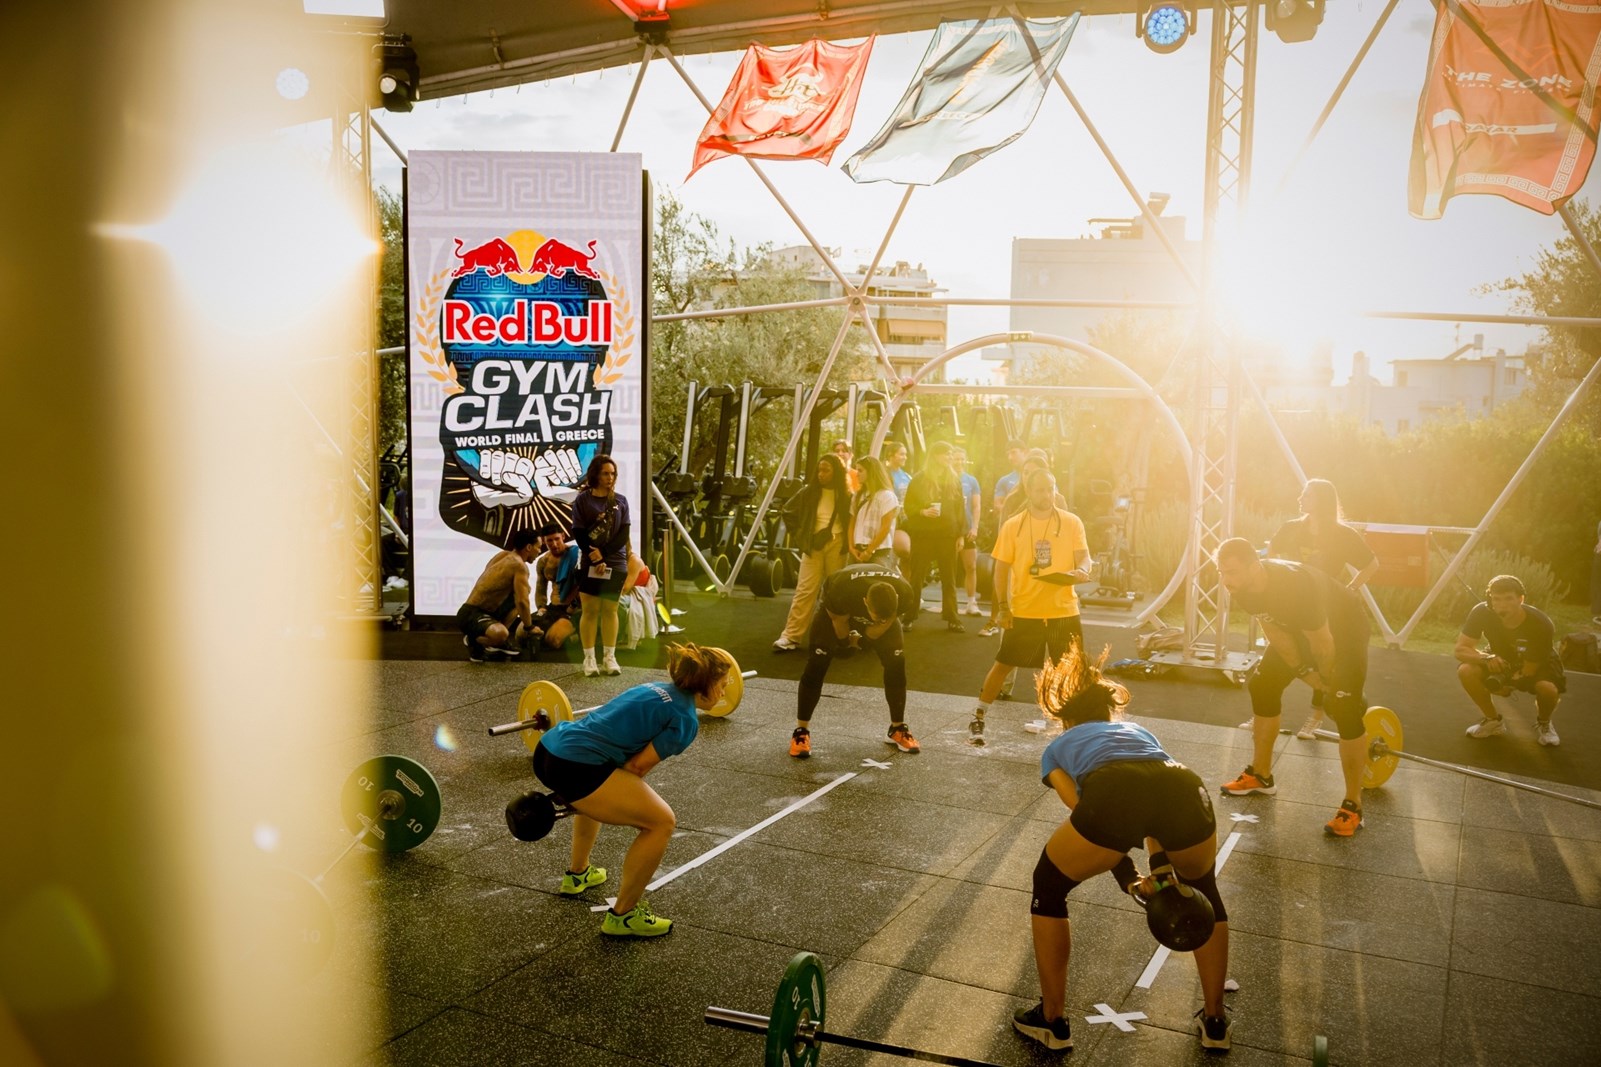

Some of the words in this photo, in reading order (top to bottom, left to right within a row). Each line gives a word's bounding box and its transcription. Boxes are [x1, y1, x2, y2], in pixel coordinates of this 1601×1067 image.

[1445, 64, 1492, 82] THE
[1500, 73, 1573, 90] ZONE
[444, 300, 526, 342] Red
[533, 301, 613, 343] Bull
[471, 359, 589, 395] GYM
[445, 391, 611, 442] CLASH
[455, 434, 501, 448] WORLD
[505, 432, 541, 445] FINAL
[555, 429, 605, 442] GREECE
[358, 776, 375, 791] 10
[406, 818, 424, 834] 10
